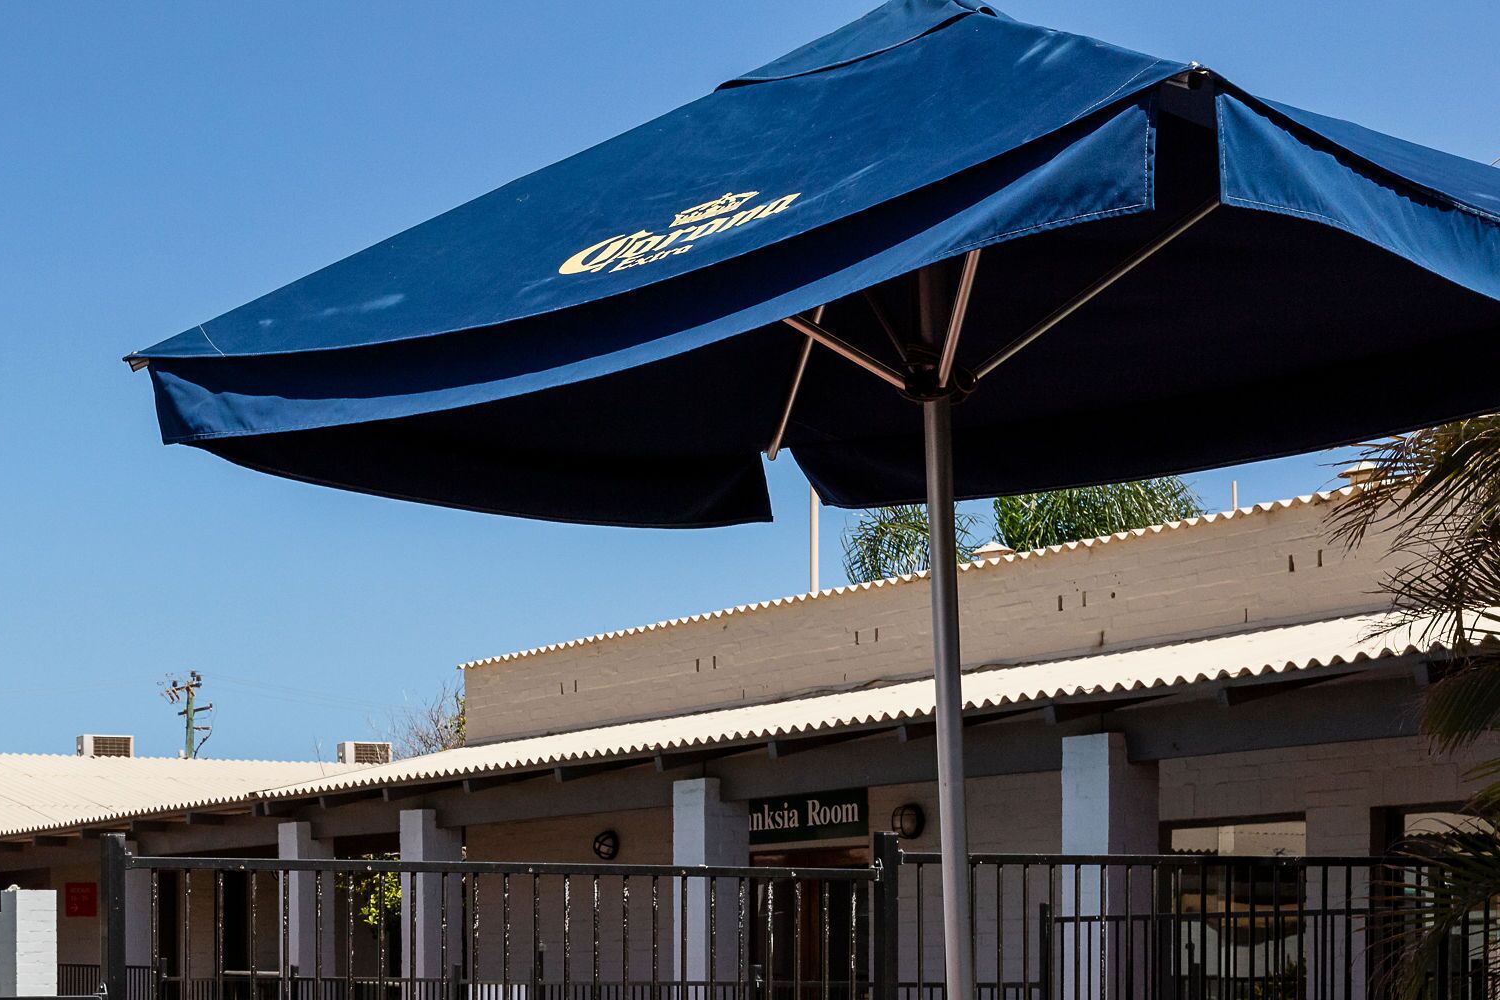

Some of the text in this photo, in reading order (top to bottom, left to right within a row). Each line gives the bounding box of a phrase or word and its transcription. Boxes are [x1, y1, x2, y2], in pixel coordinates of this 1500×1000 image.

[558, 192, 802, 275] Corona
[608, 244, 694, 273] Extra
[806, 799, 859, 827] Room
